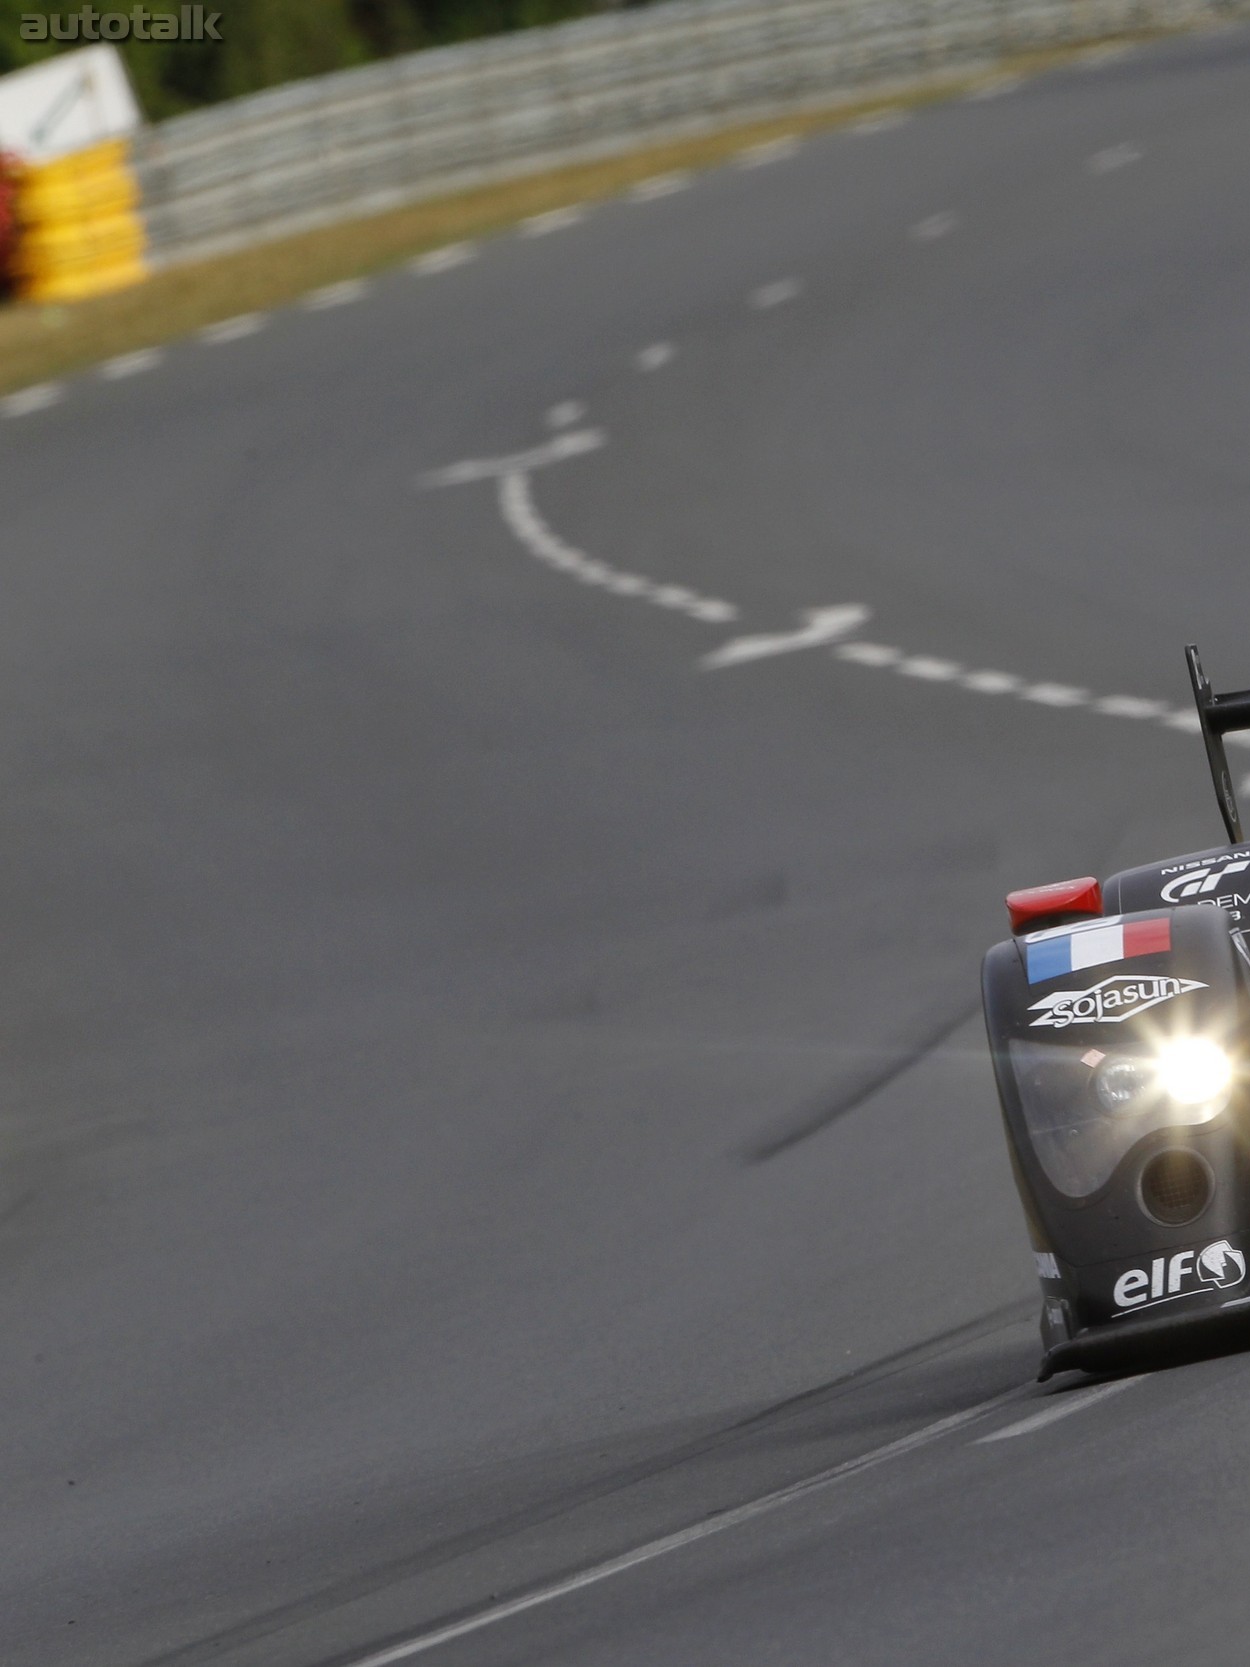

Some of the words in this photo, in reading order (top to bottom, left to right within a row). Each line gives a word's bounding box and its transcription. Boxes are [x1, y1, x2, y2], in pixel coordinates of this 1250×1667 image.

[1161, 851, 1250, 875] NISSAN
[1050, 976, 1182, 1029] sojasun
[1112, 1249, 1198, 1308] elf
